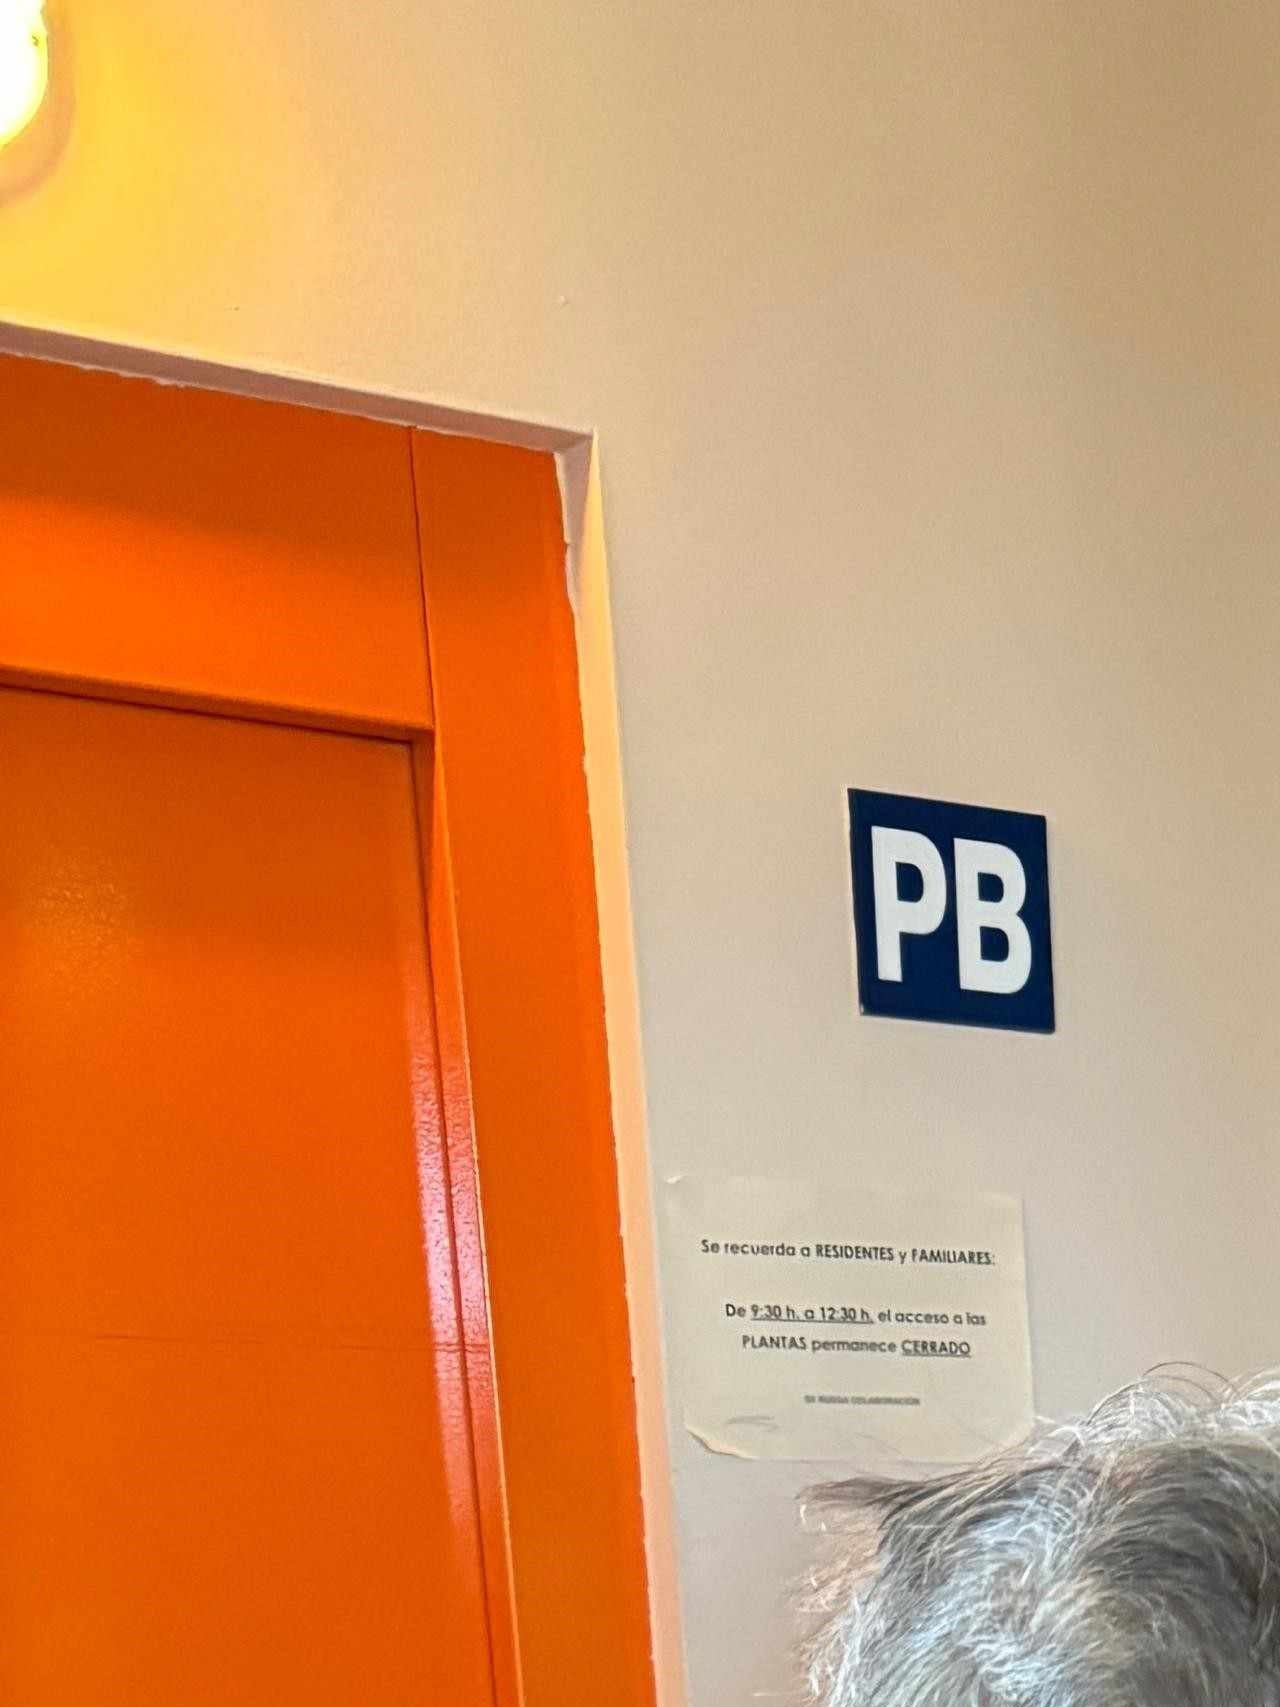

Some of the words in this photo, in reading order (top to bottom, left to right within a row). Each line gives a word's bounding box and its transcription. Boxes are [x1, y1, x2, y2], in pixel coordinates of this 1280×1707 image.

[870, 824, 1034, 995] PB
[701, 1239, 720, 1254] Se
[724, 1241, 795, 1257] recuerda
[800, 1246, 810, 1258] a
[815, 1244, 894, 1262] RESIDENTES
[899, 1251, 906, 1265] y
[912, 1248, 996, 1266] FAMILIARES:
[725, 1303, 746, 1318] De
[751, 1304, 783, 1320] 9:30
[786, 1304, 800, 1321] h.
[804, 1308, 815, 1321] a
[820, 1306, 857, 1323] 12:30
[860, 1308, 873, 1324] h.
[878, 1309, 891, 1323] el
[895, 1312, 949, 1325] acceso
[954, 1315, 962, 1325] a
[966, 1312, 986, 1326] las
[742, 1334, 807, 1350] PLANTAS
[812, 1338, 897, 1355] permanece
[902, 1340, 971, 1355] CERRADO
